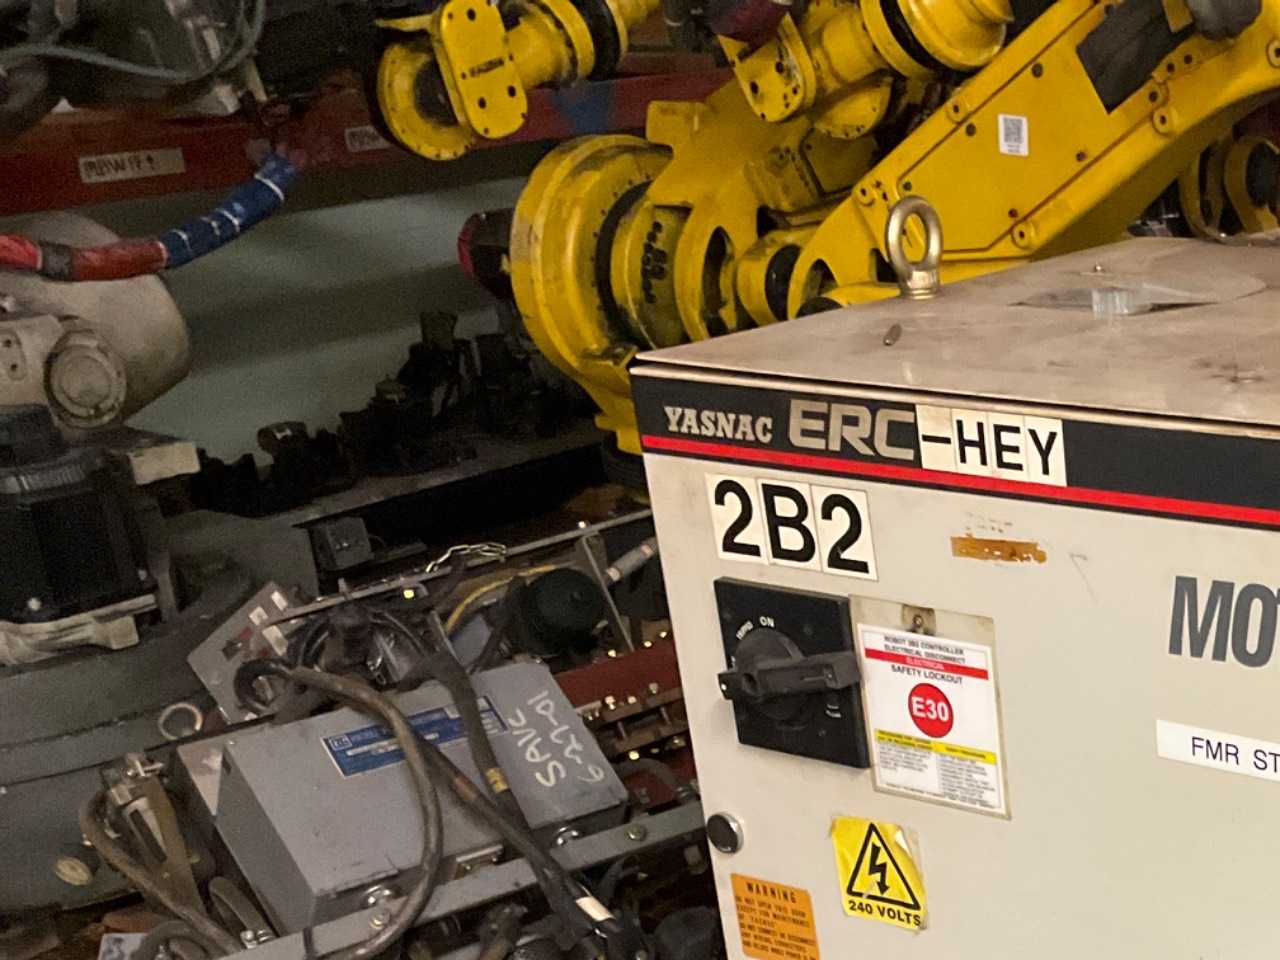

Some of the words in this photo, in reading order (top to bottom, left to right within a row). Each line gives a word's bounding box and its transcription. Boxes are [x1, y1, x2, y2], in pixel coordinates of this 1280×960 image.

[664, 406, 773, 444] YASNAC
[714, 479, 870, 574] 2B2
[759, 616, 775, 628] ON
[884, 644, 922, 658] ELECTRICAL
[920, 641, 964, 656] CONTROLLER
[891, 664, 922, 678] SAFETY
[923, 669, 963, 684] LOCKOUT
[911, 696, 949, 722] E30
[1192, 736, 1239, 765] FMR
[746, 882, 796, 904] WARNING
[848, 899, 873, 915] 240
[877, 904, 921, 926] VOLTS
